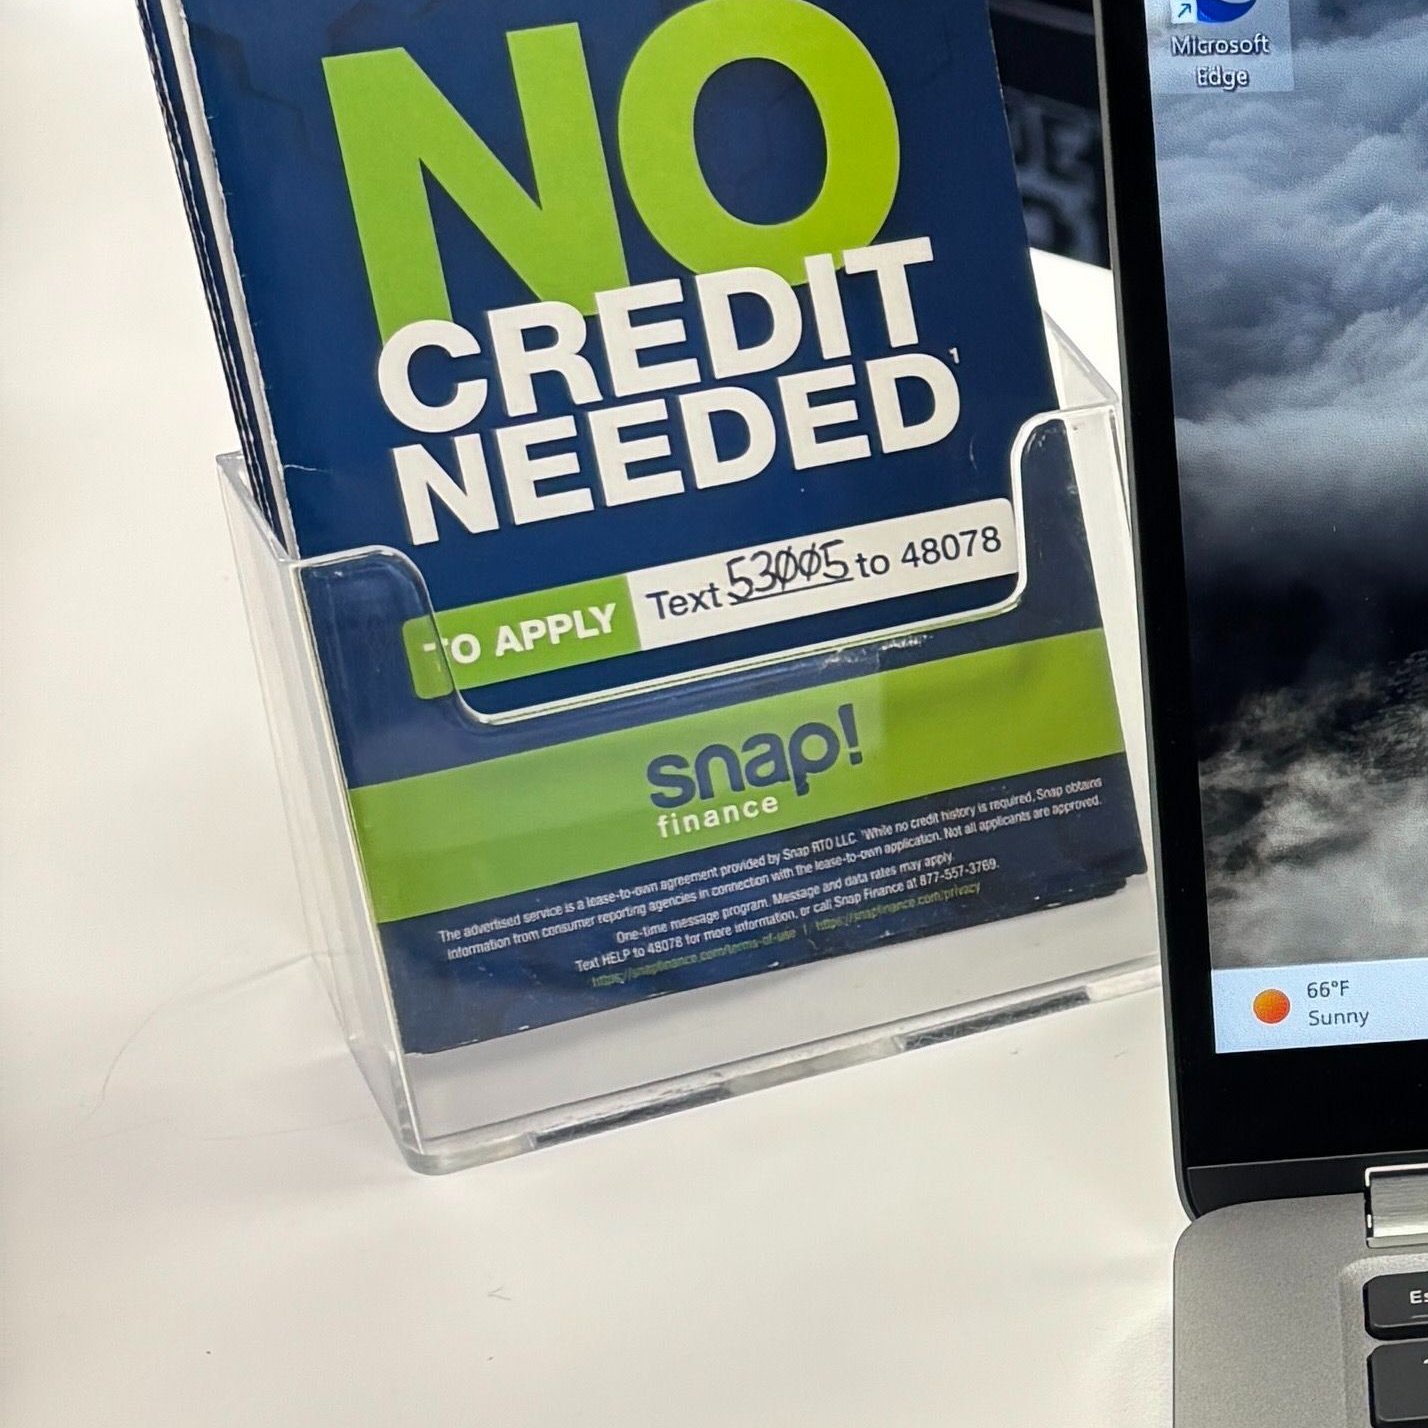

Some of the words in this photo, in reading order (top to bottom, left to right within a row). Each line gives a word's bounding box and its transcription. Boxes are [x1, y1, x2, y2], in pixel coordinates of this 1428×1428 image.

[1170, 35, 1269, 56] Microsoft
[1198, 65, 1246, 89] Edge
[377, 236, 935, 435] CREDIT
[646, 584, 720, 622] Text
[855, 551, 890, 580] to
[900, 525, 1001, 571] 48078
[495, 603, 616, 657] APPLY
[647, 703, 864, 808] snap!
[656, 793, 779, 839] finance
[438, 930, 460, 941] The
[463, 914, 520, 936] advertised
[523, 905, 562, 922] service
[585, 882, 657, 907] lease-to-own
[660, 867, 718, 890] agreement
[719, 855, 765, 876] provided
[767, 853, 780, 864] by
[782, 846, 809, 859] Snap
[895, 821, 908, 831] no
[910, 812, 938, 828] credit
[940, 806, 974, 820] history
[1036, 786, 1062, 799] Snap
[512, 930, 539, 943] from
[541, 916, 594, 937] consumer
[597, 904, 646, 923] reporting
[648, 892, 696, 911] agencies
[698, 889, 709, 898] in
[711, 874, 768, 895] connection
[770, 868, 793, 880] with
[794, 863, 812, 875] the
[814, 846, 882, 869] lease-to-own
[943, 825, 961, 838] Not
[964, 822, 976, 833] all
[979, 811, 1030, 831] applicants
[1033, 807, 1049, 818] are
[670, 911, 719, 929] message
[772, 885, 819, 904] Message
[822, 877, 841, 892] and
[844, 873, 867, 886] data
[870, 866, 896, 879] rates
[899, 860, 920, 872] may
[574, 957, 599, 970] Text
[601, 948, 630, 965] HELP
[632, 947, 644, 957] to
[647, 936, 682, 953] 48078
[684, 933, 699, 944] for
[703, 926, 731, 940] more
[800, 906, 809, 916] or
[813, 898, 831, 912] call
[833, 893, 860, 907] Snap
[863, 882, 903, 899] Finance
[906, 877, 917, 888] at
[1307, 980, 1349, 998] 66°F
[1309, 1010, 1369, 1027] Sunny
